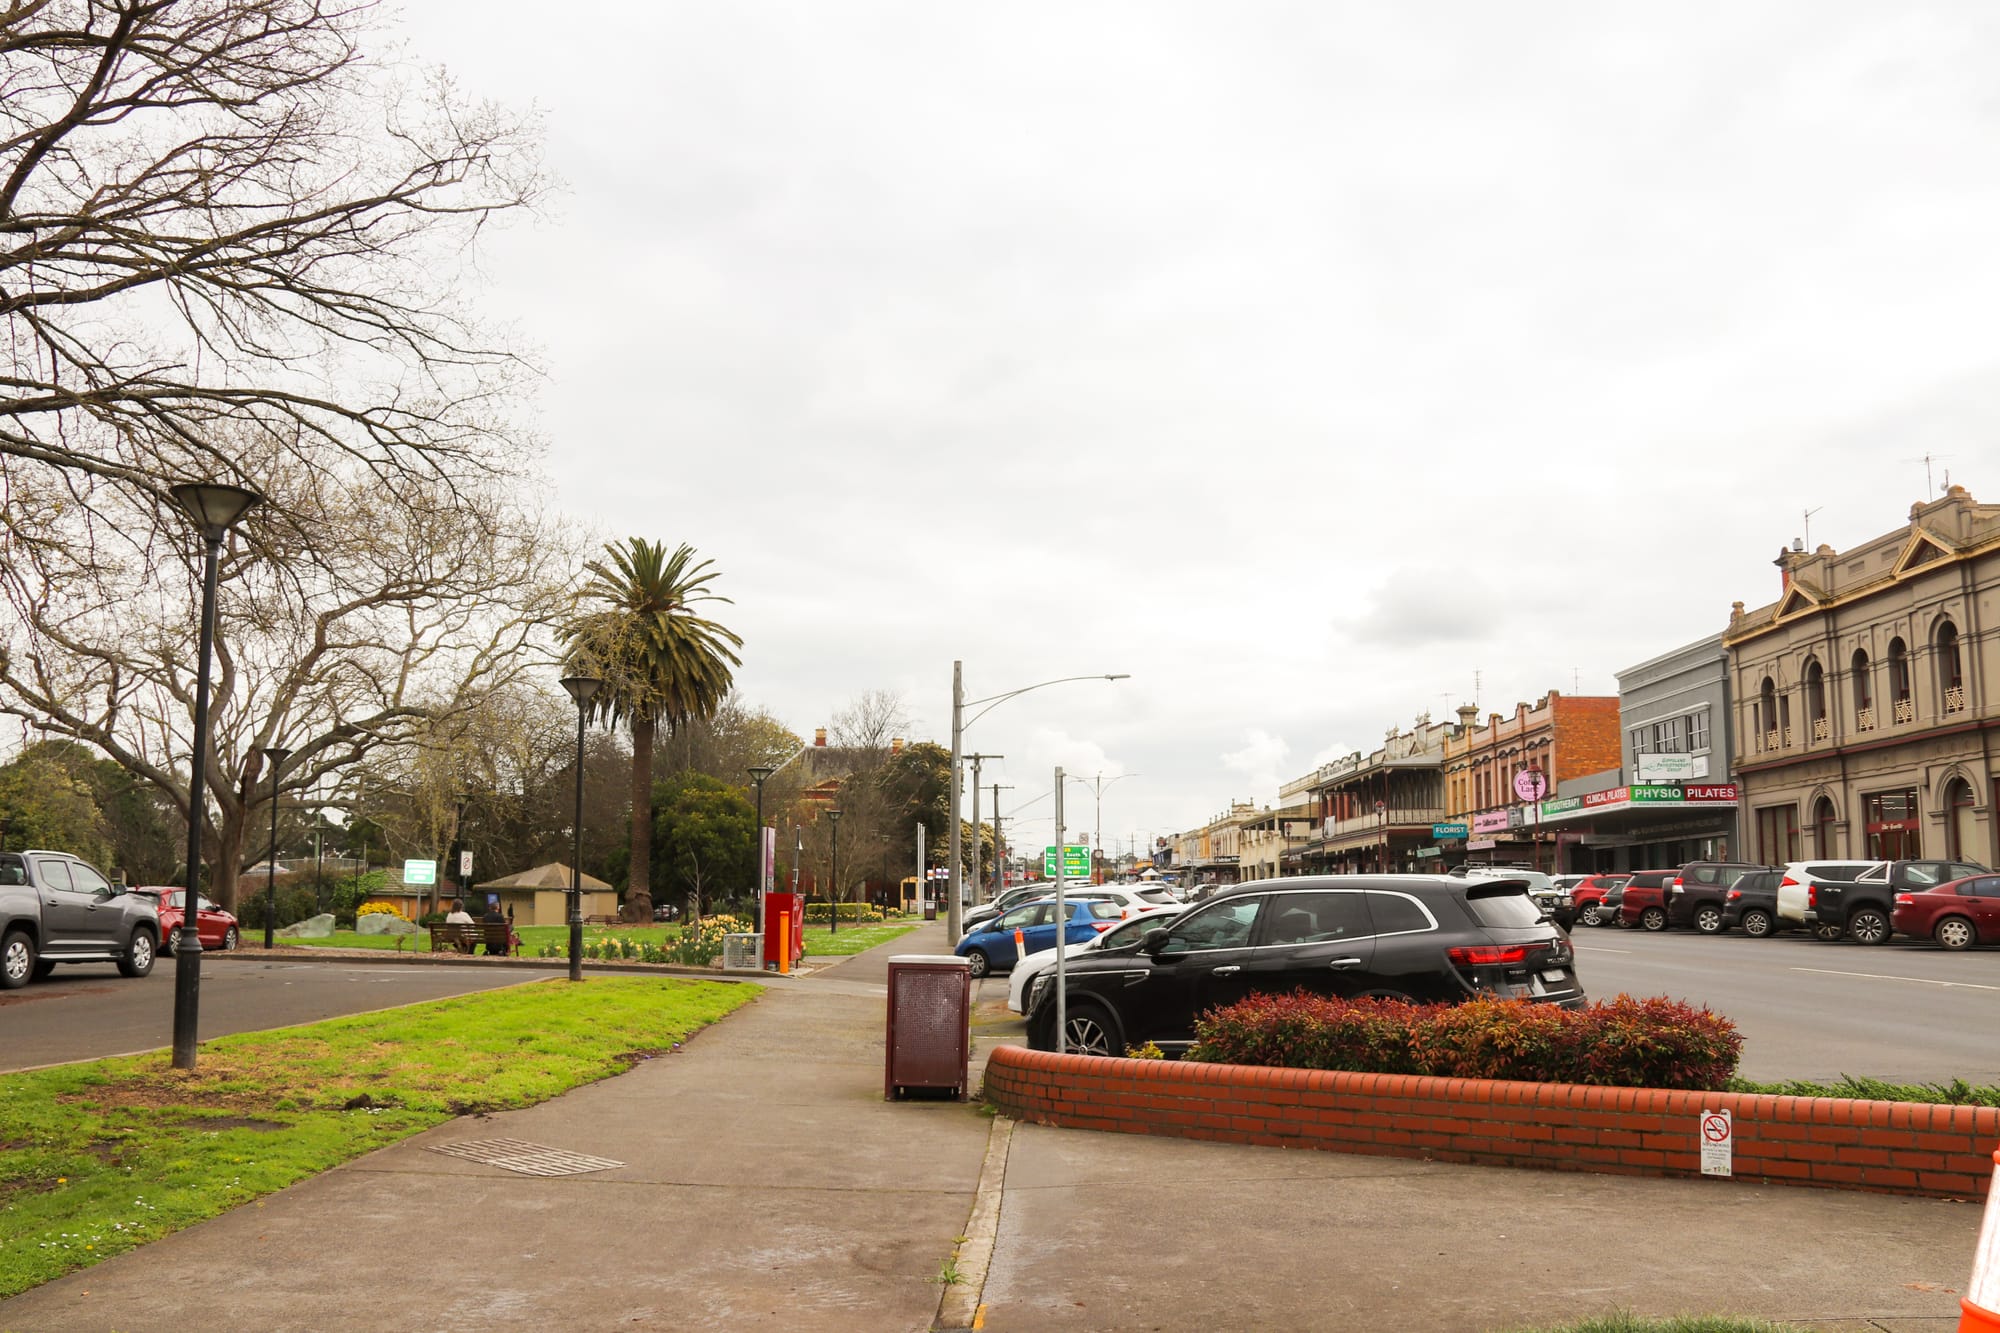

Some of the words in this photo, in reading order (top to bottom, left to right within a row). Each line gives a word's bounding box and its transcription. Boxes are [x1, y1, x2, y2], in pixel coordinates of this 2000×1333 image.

[1586, 792, 1607, 804] CLINICAL
[1607, 788, 1627, 800] PILATES
[1634, 788, 1681, 798] PHYSIO
[1687, 788, 1735, 798] PILATES
[1545, 797, 1580, 812] PHYSIOTHERAPY
[1435, 826, 1465, 834] FLORIST
